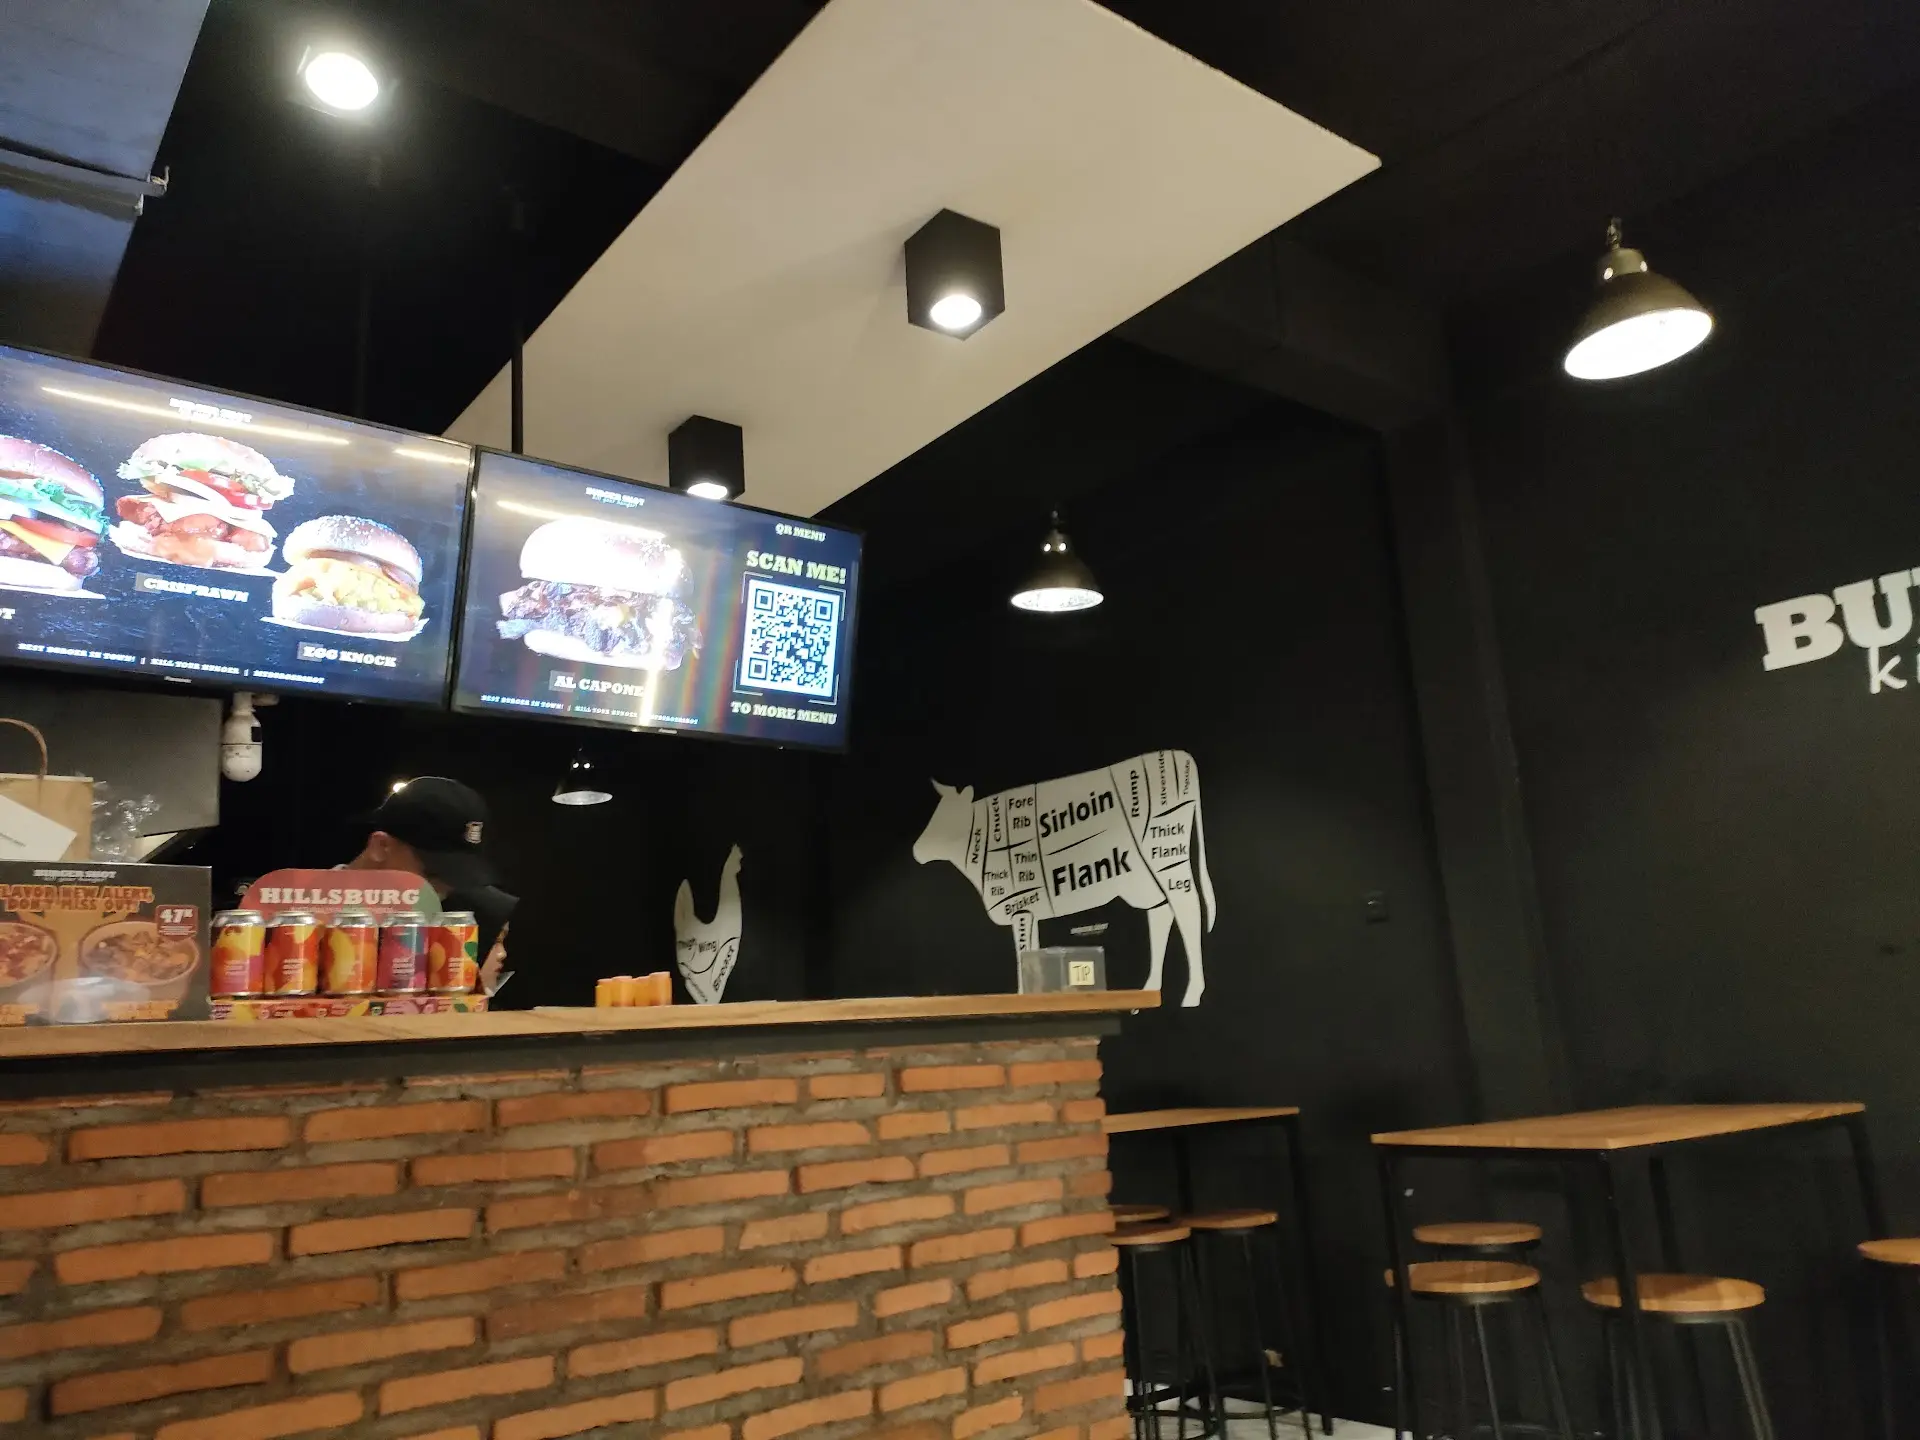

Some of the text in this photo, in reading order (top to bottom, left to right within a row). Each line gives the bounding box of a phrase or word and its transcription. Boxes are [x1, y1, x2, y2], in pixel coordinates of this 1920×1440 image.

[775, 523, 827, 542] QR MENU
[746, 550, 847, 585] SCAN ME!
[1754, 566, 1920, 672] BU
[303, 645, 398, 668] EGG KNOCK
[554, 675, 646, 698] AL CAPONE
[730, 701, 838, 725] TO MORE MENU
[1130, 769, 1141, 818] Rump
[1008, 796, 1034, 811] Fore
[993, 796, 1002, 843] Chuck
[1013, 815, 1032, 830] Rib
[1039, 789, 1115, 839] Sirloin
[1150, 822, 1186, 839] Thick
[971, 827, 983, 864] Neck
[1151, 843, 1187, 860] Flank
[1014, 851, 1038, 865] Thin
[984, 868, 1009, 882] Thick
[1019, 870, 1036, 882] Rib
[1052, 847, 1133, 897] Flank
[991, 886, 1005, 896] Rib
[1167, 878, 1192, 893] Leg
[260, 887, 420, 905] HILLSBURG
[1004, 891, 1040, 916] Brisket
[1072, 964, 1091, 983] TIP
